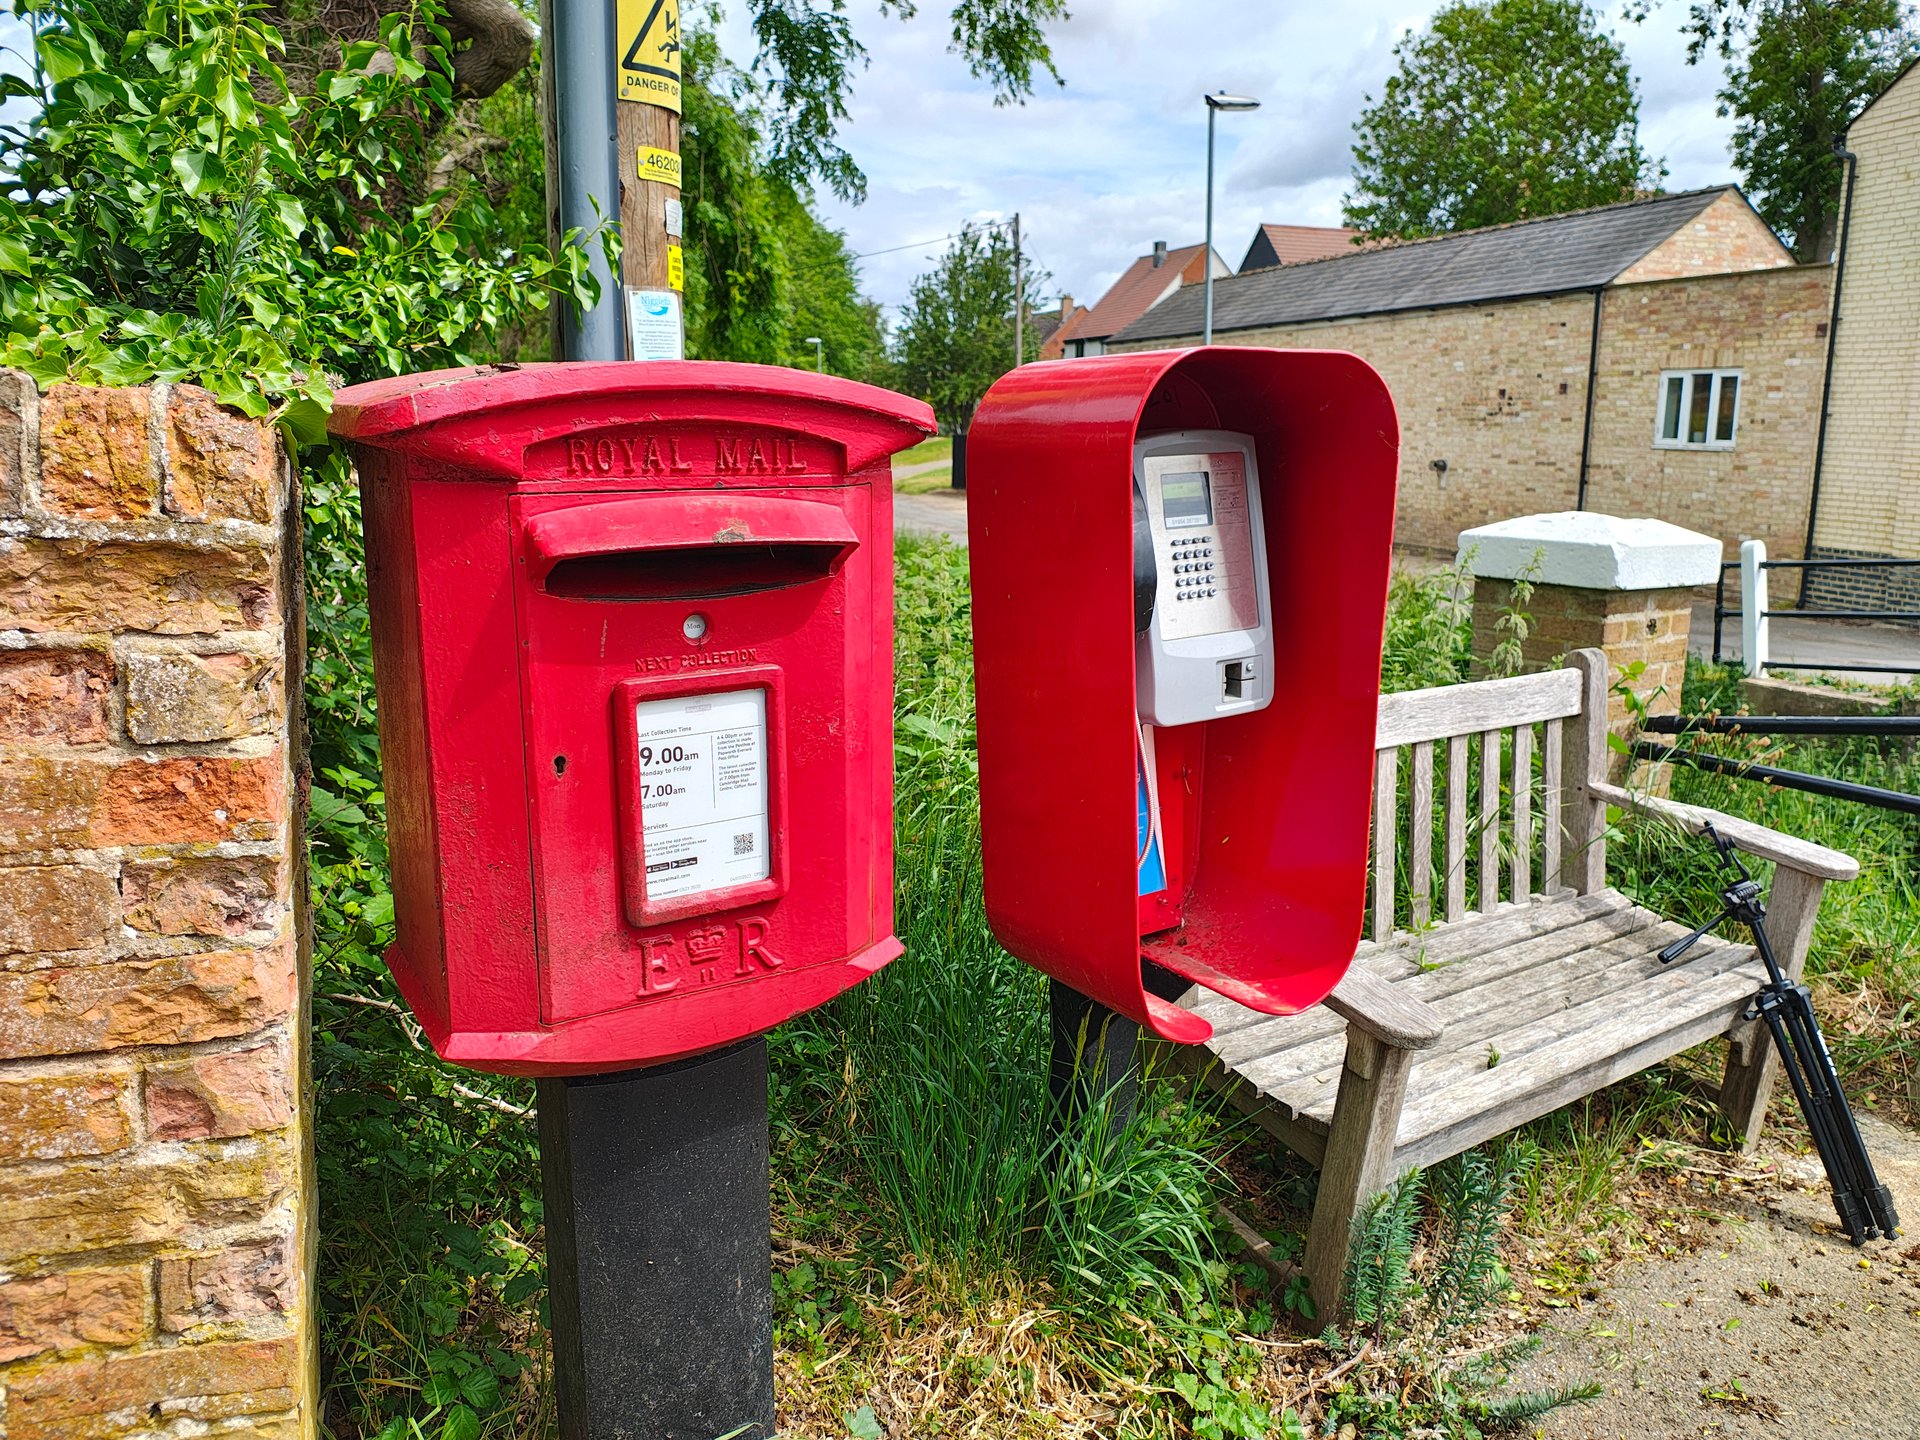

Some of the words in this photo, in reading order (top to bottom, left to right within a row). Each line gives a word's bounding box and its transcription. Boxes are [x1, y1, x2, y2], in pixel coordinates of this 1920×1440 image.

[626, 76, 669, 92] DANGER
[647, 153, 681, 173] 46203
[566, 437, 692, 475] ROYAL
[714, 437, 807, 474] MAIL
[635, 656, 673, 672] NEXT
[680, 648, 757, 668] COLLECTION
[640, 746, 699, 767] 9.00am
[641, 784, 686, 799] 7.00am
[641, 801, 669, 810] Saturday
[642, 823, 668, 832] Services
[636, 933, 682, 998] E
[734, 916, 784, 977] R
